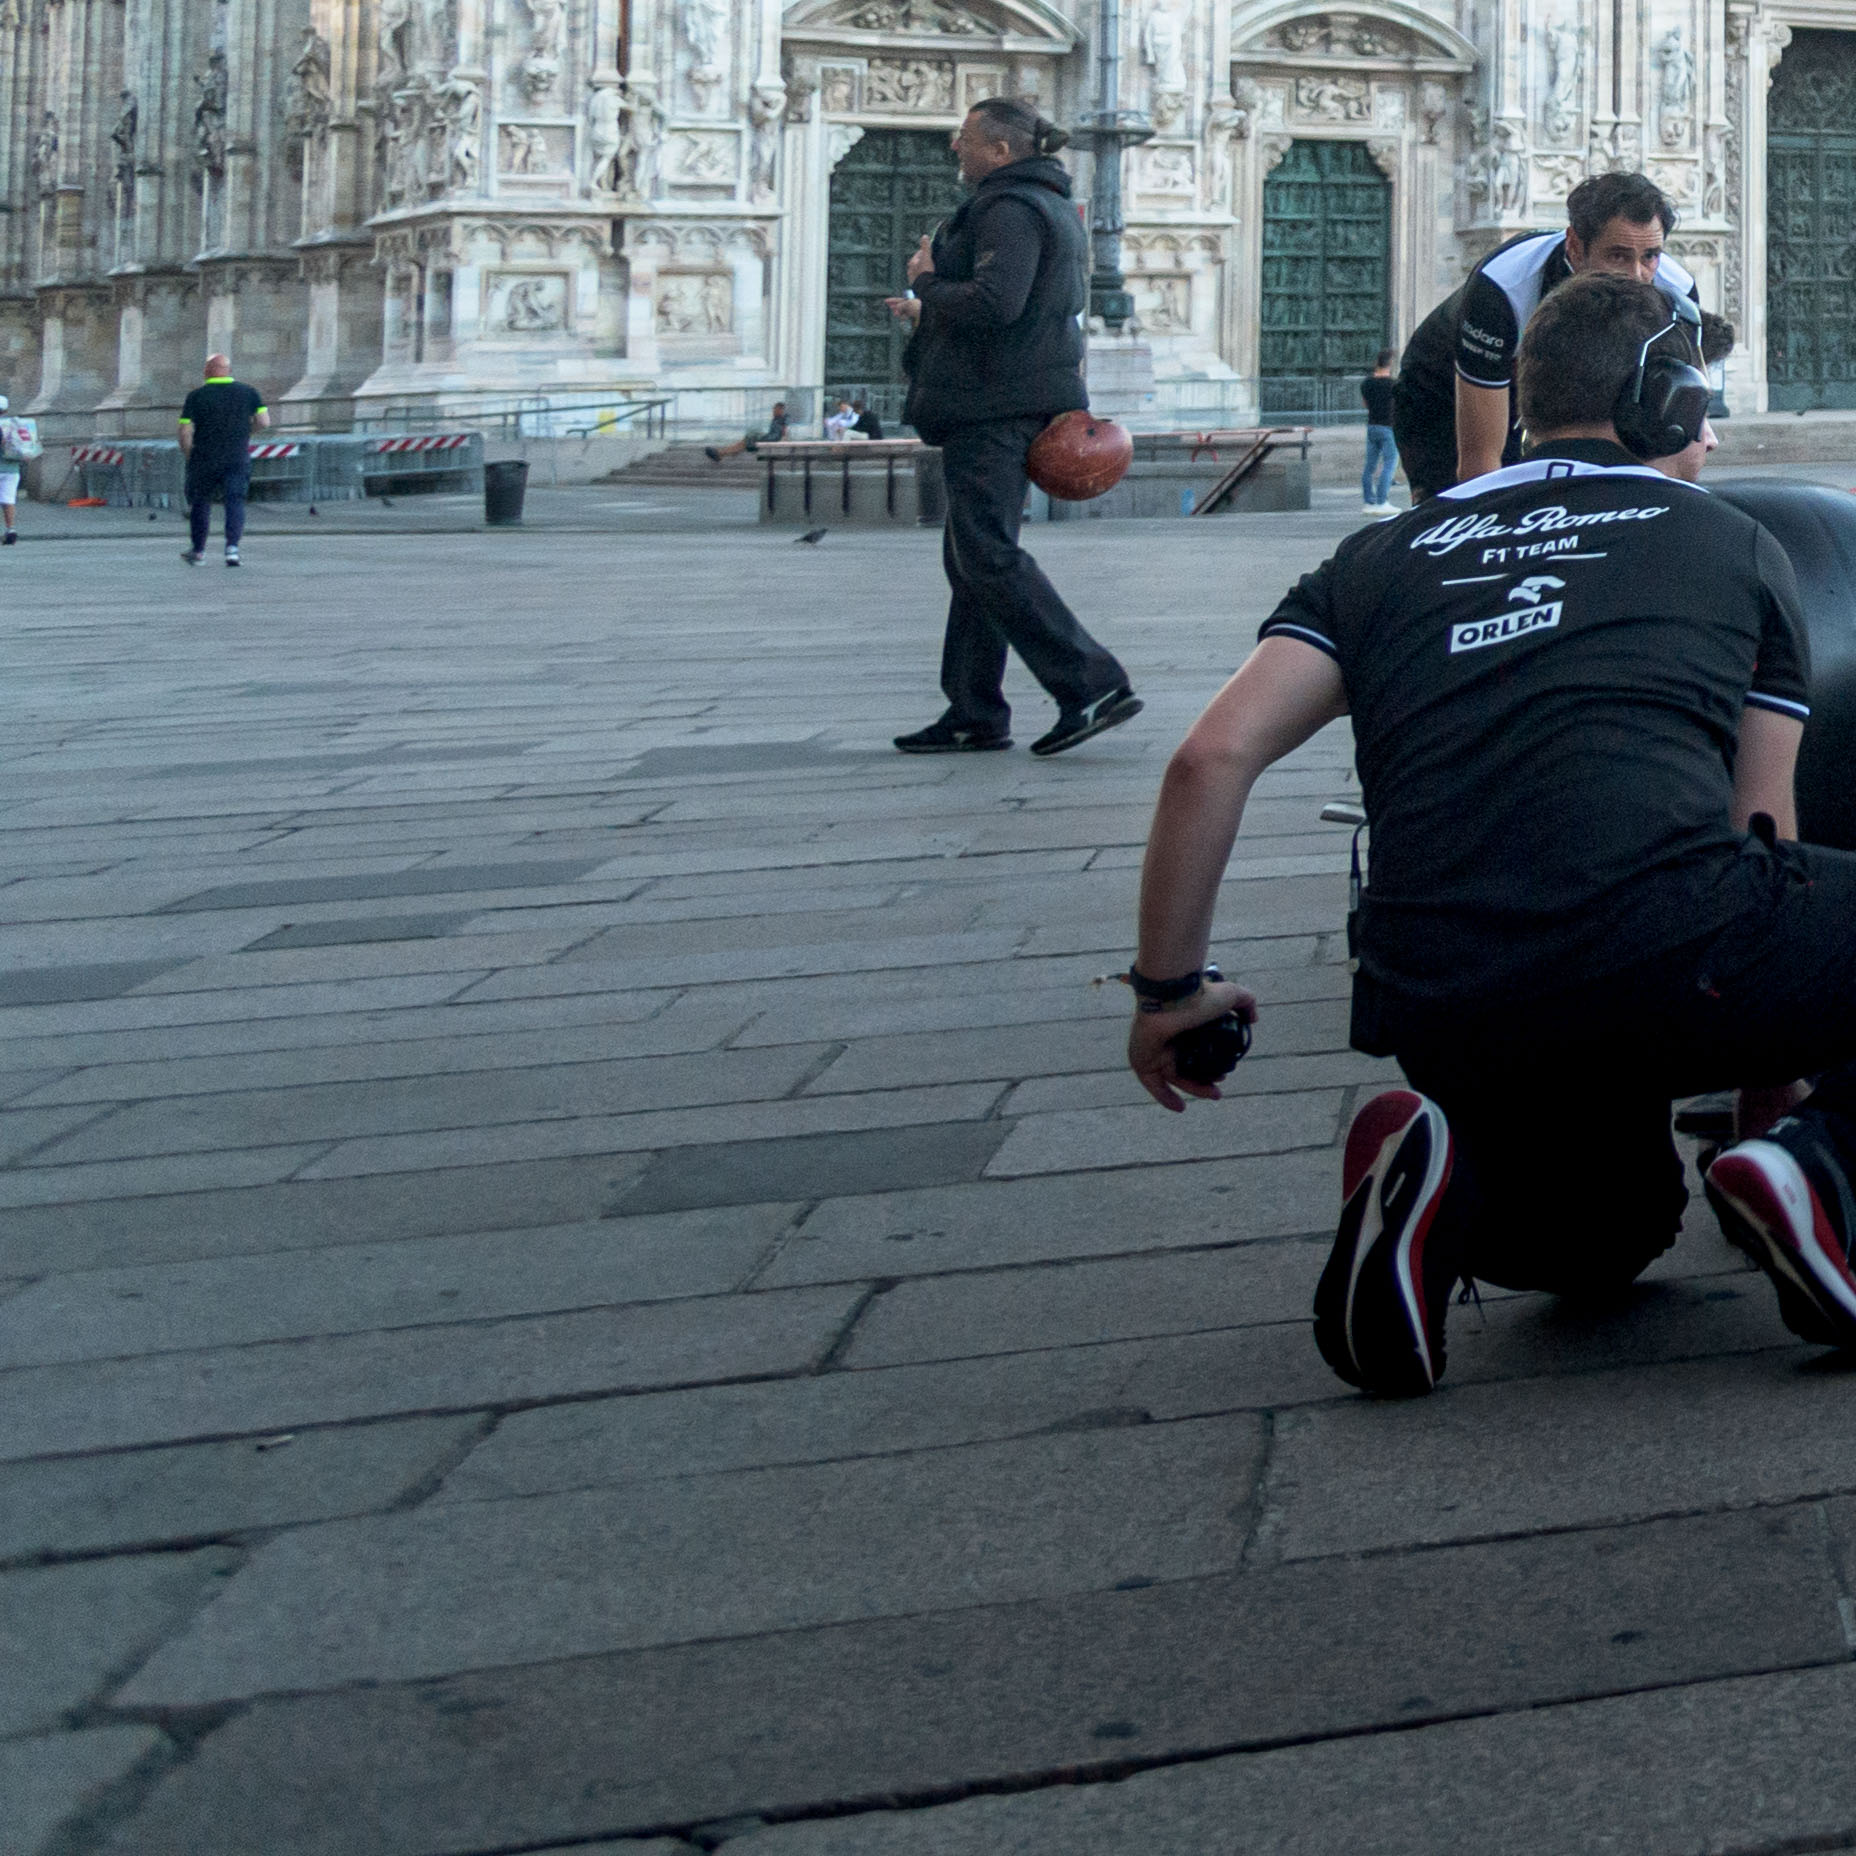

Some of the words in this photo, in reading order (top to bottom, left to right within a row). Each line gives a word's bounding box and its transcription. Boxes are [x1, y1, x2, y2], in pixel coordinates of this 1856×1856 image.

[1410, 513, 1513, 556] Alfa
[1512, 505, 1670, 535] Romeo
[1482, 547, 1507, 564] F1
[1516, 535, 1579, 559] TEAM
[1457, 606, 1554, 645] ORLEN
